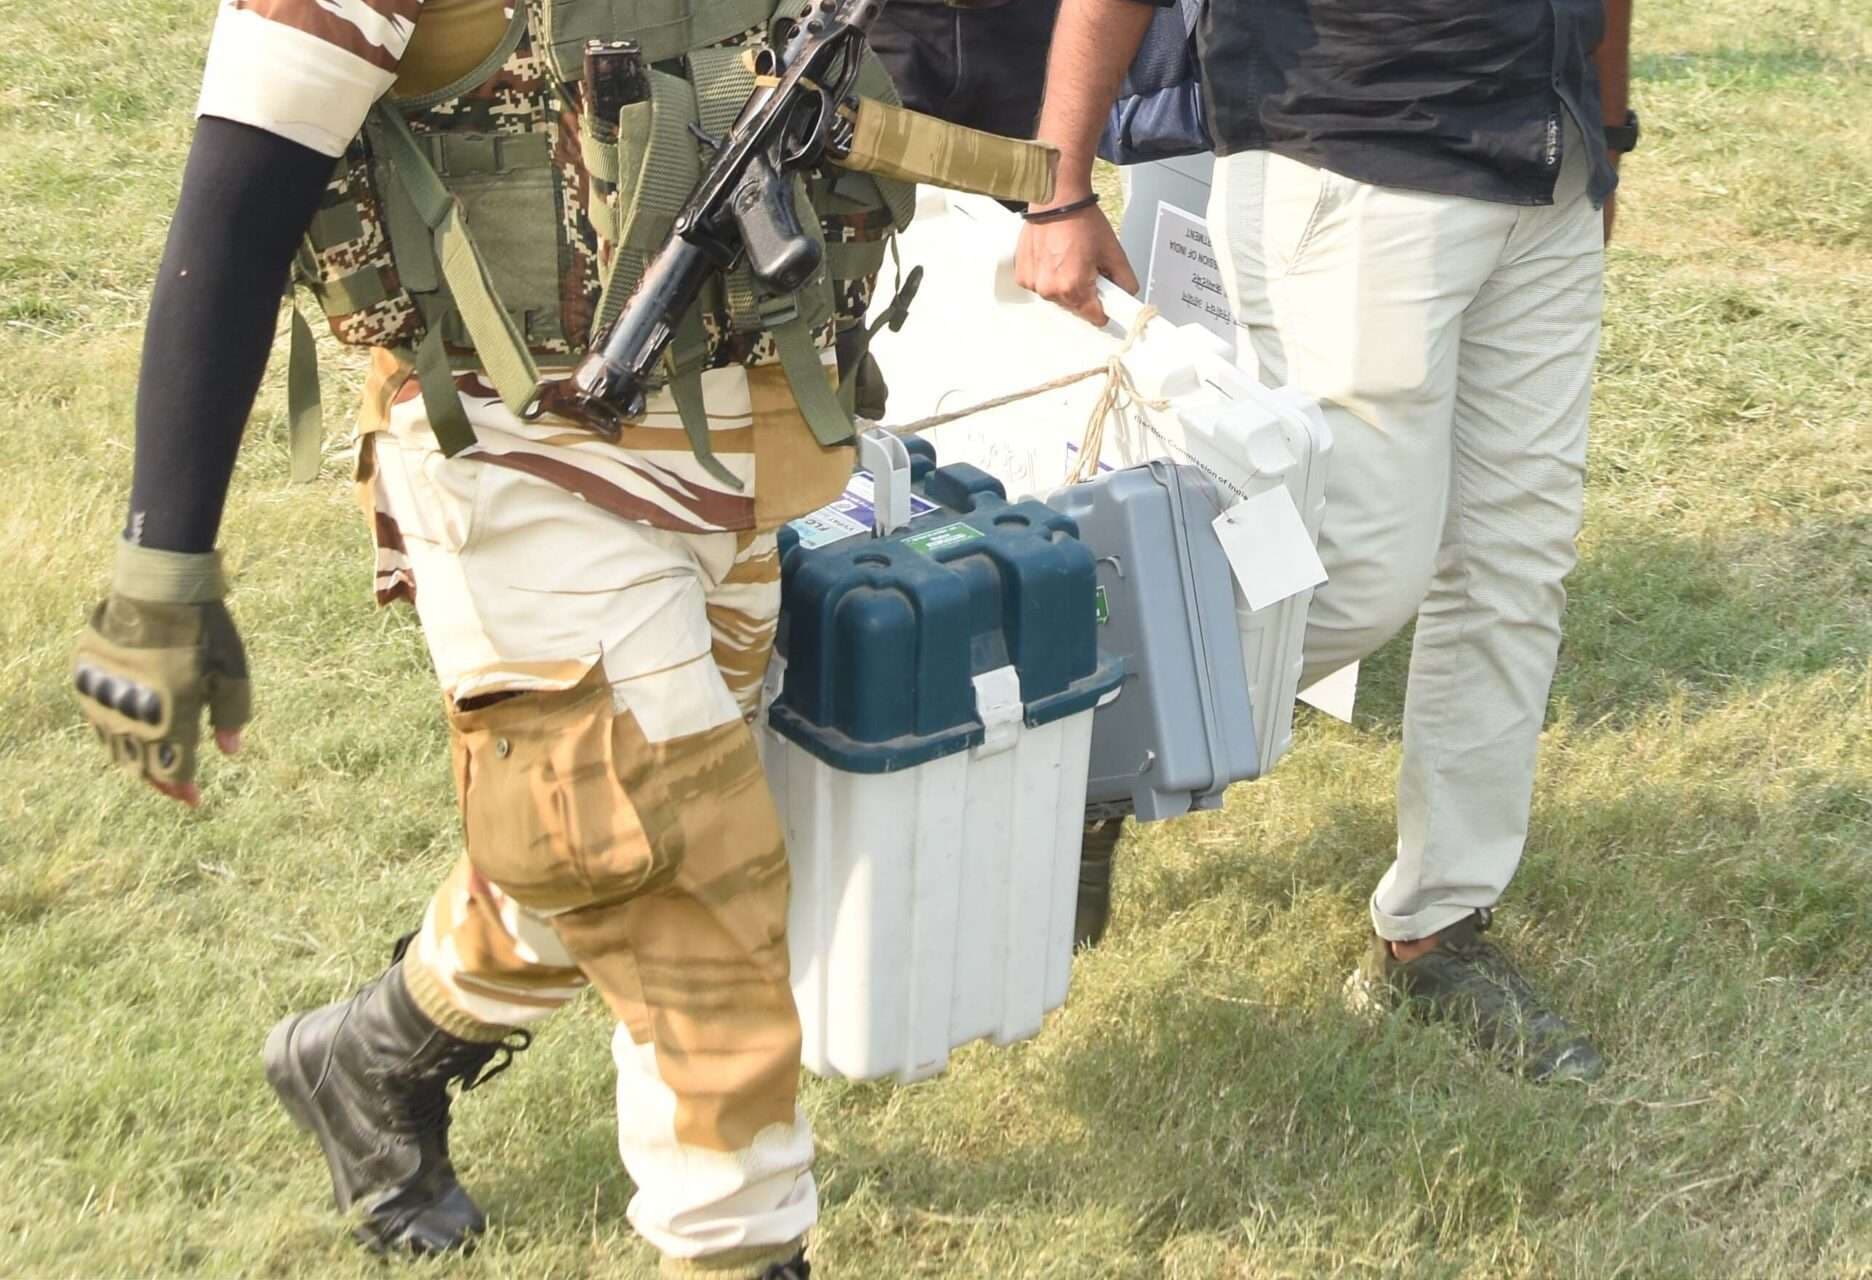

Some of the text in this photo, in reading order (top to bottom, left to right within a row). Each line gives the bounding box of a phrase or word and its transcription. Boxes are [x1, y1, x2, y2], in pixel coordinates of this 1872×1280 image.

[1169, 239, 1187, 257] INDIA
[1217, 474, 1228, 486] of
[1228, 481, 1249, 501] India
